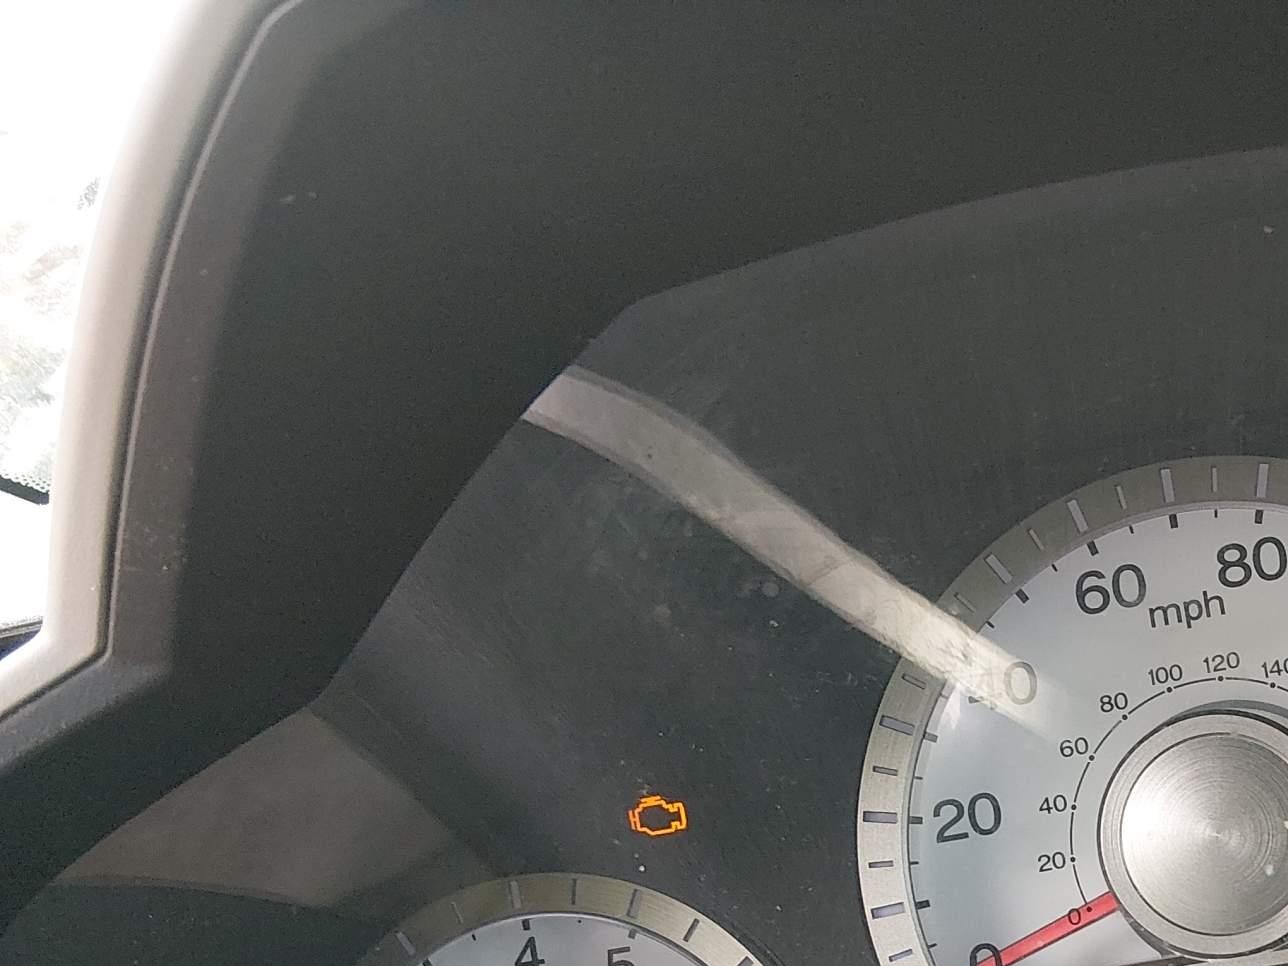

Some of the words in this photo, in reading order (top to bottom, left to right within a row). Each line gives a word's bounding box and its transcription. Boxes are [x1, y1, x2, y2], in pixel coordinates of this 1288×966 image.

[1216, 537, 1288, 588] 80
[1075, 563, 1147, 615] 60
[1149, 590, 1226, 629] mph
[1203, 652, 1241, 673] 120
[1148, 664, 1183, 685] 100
[968, 662, 1038, 710] 0
[1100, 692, 1128, 713] 80
[1059, 737, 1089, 758] 60
[1039, 794, 1068, 815] 40
[932, 792, 1002, 844] 20
[1037, 851, 1067, 872] 20
[1067, 908, 1082, 925] 0
